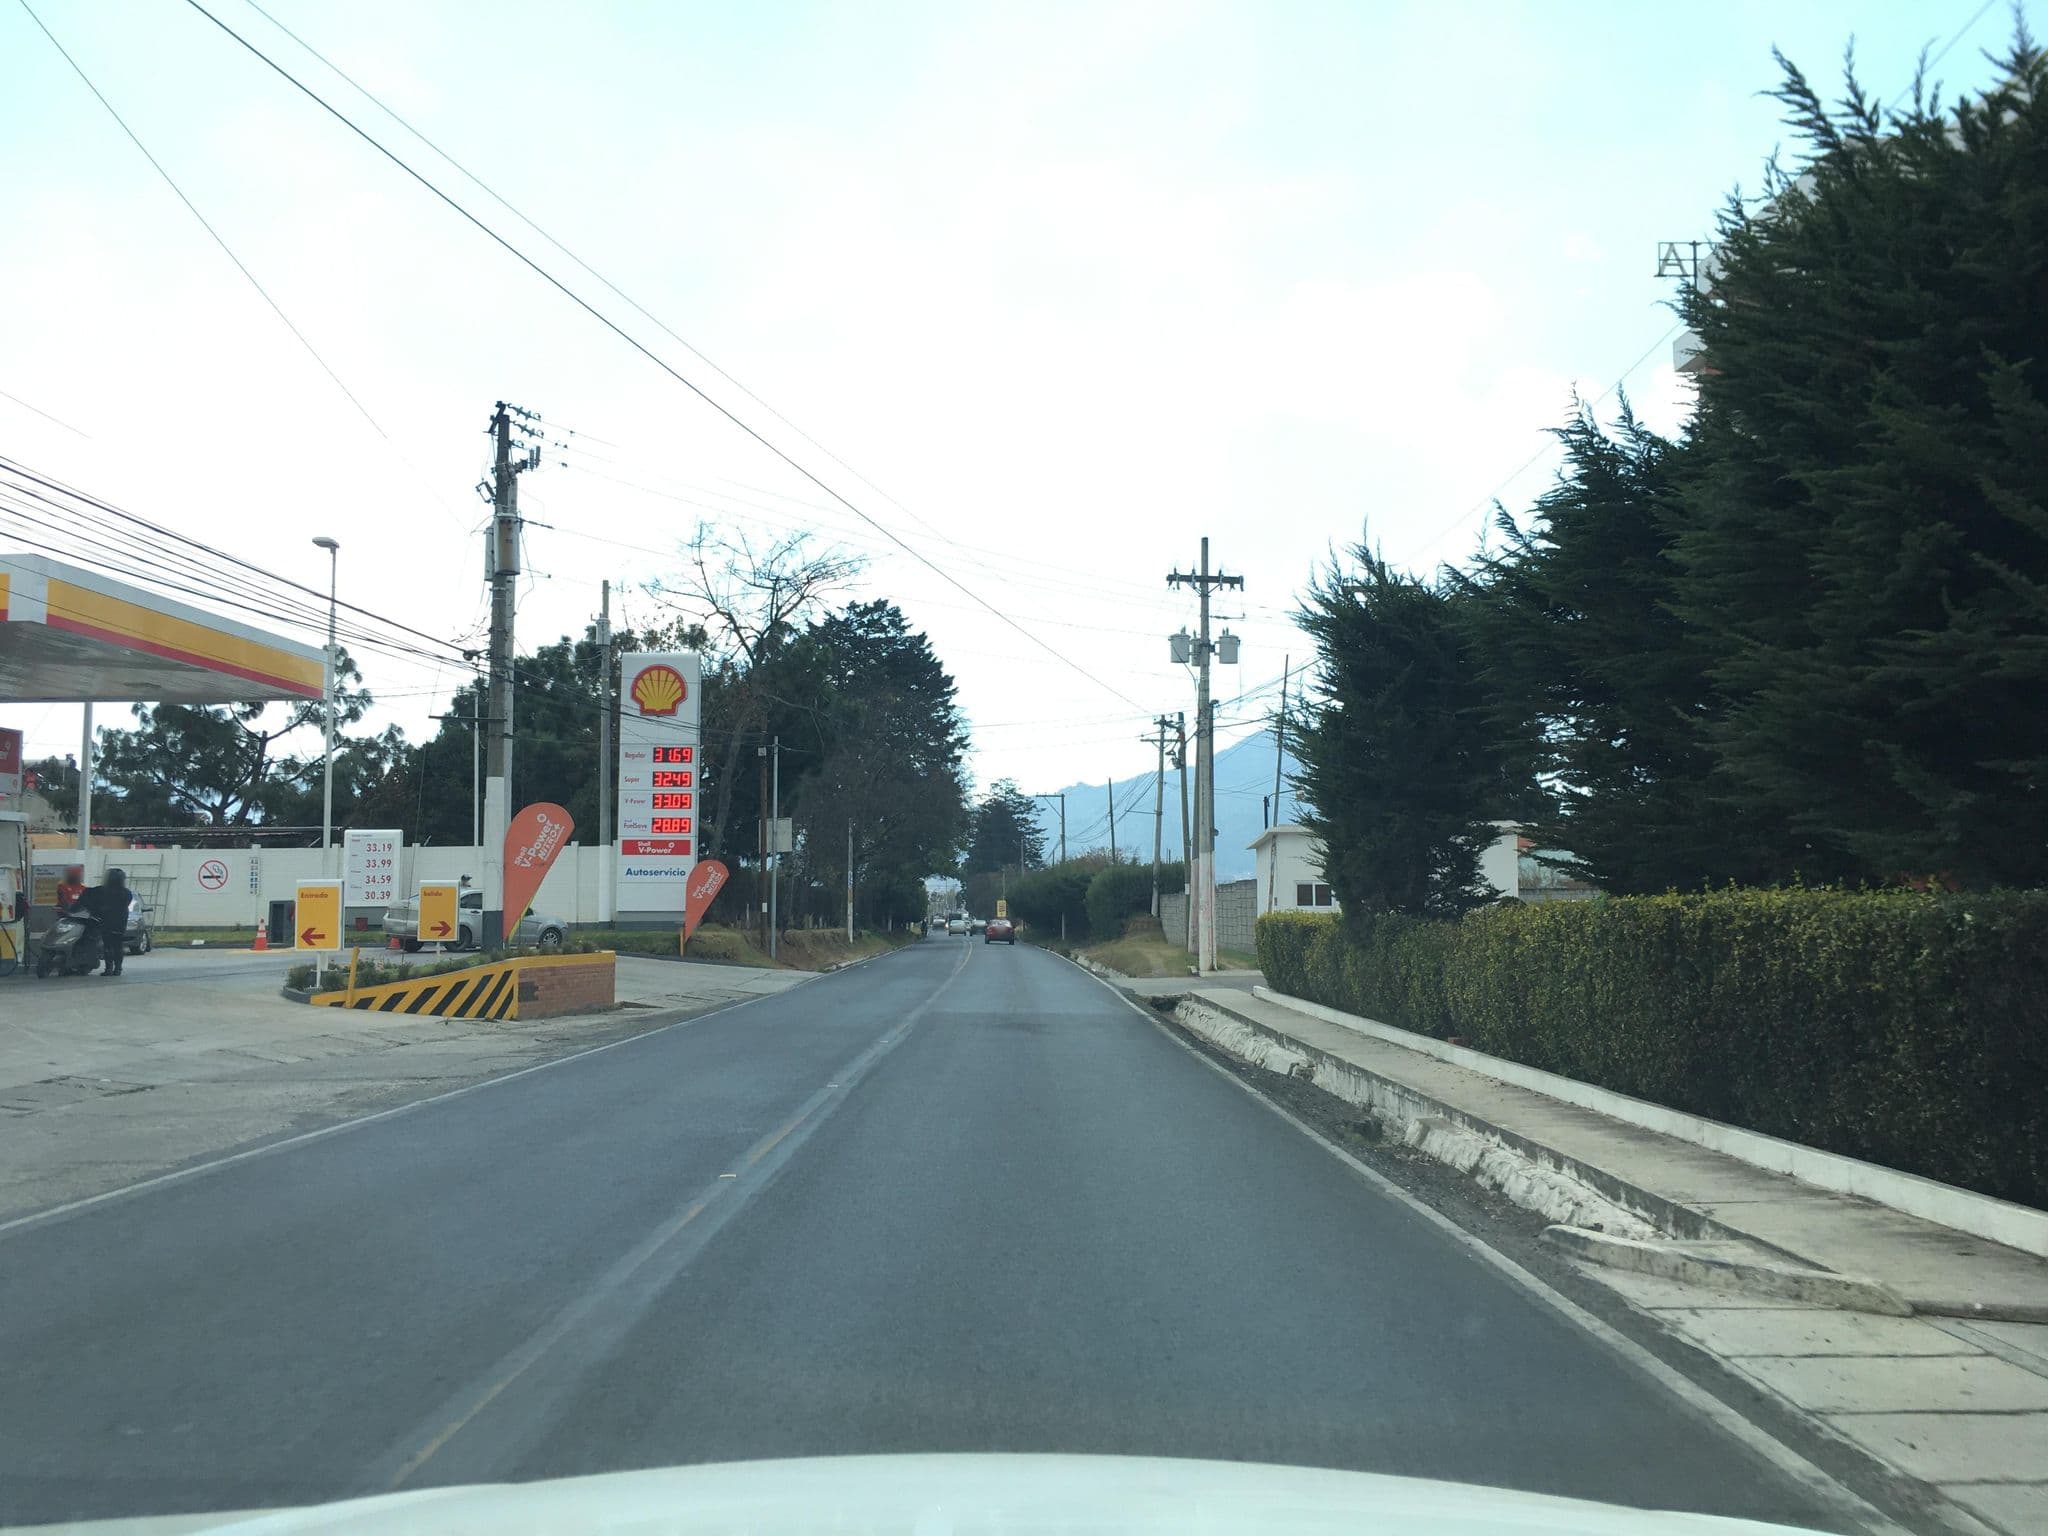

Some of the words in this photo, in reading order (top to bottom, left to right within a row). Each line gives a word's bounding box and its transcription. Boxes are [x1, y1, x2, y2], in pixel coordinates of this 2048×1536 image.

[625, 751, 647, 760] Regular
[624, 775, 640, 784] Super
[654, 772, 690, 786] 32.49
[366, 843, 392, 852] 33.19
[519, 819, 553, 867] V-Power
[514, 846, 528, 864] Shell
[366, 859, 392, 868] 33.99
[625, 867, 686, 877] Autoservicio
[365, 875, 391, 884] 34.59
[364, 891, 391, 900] 30.39
